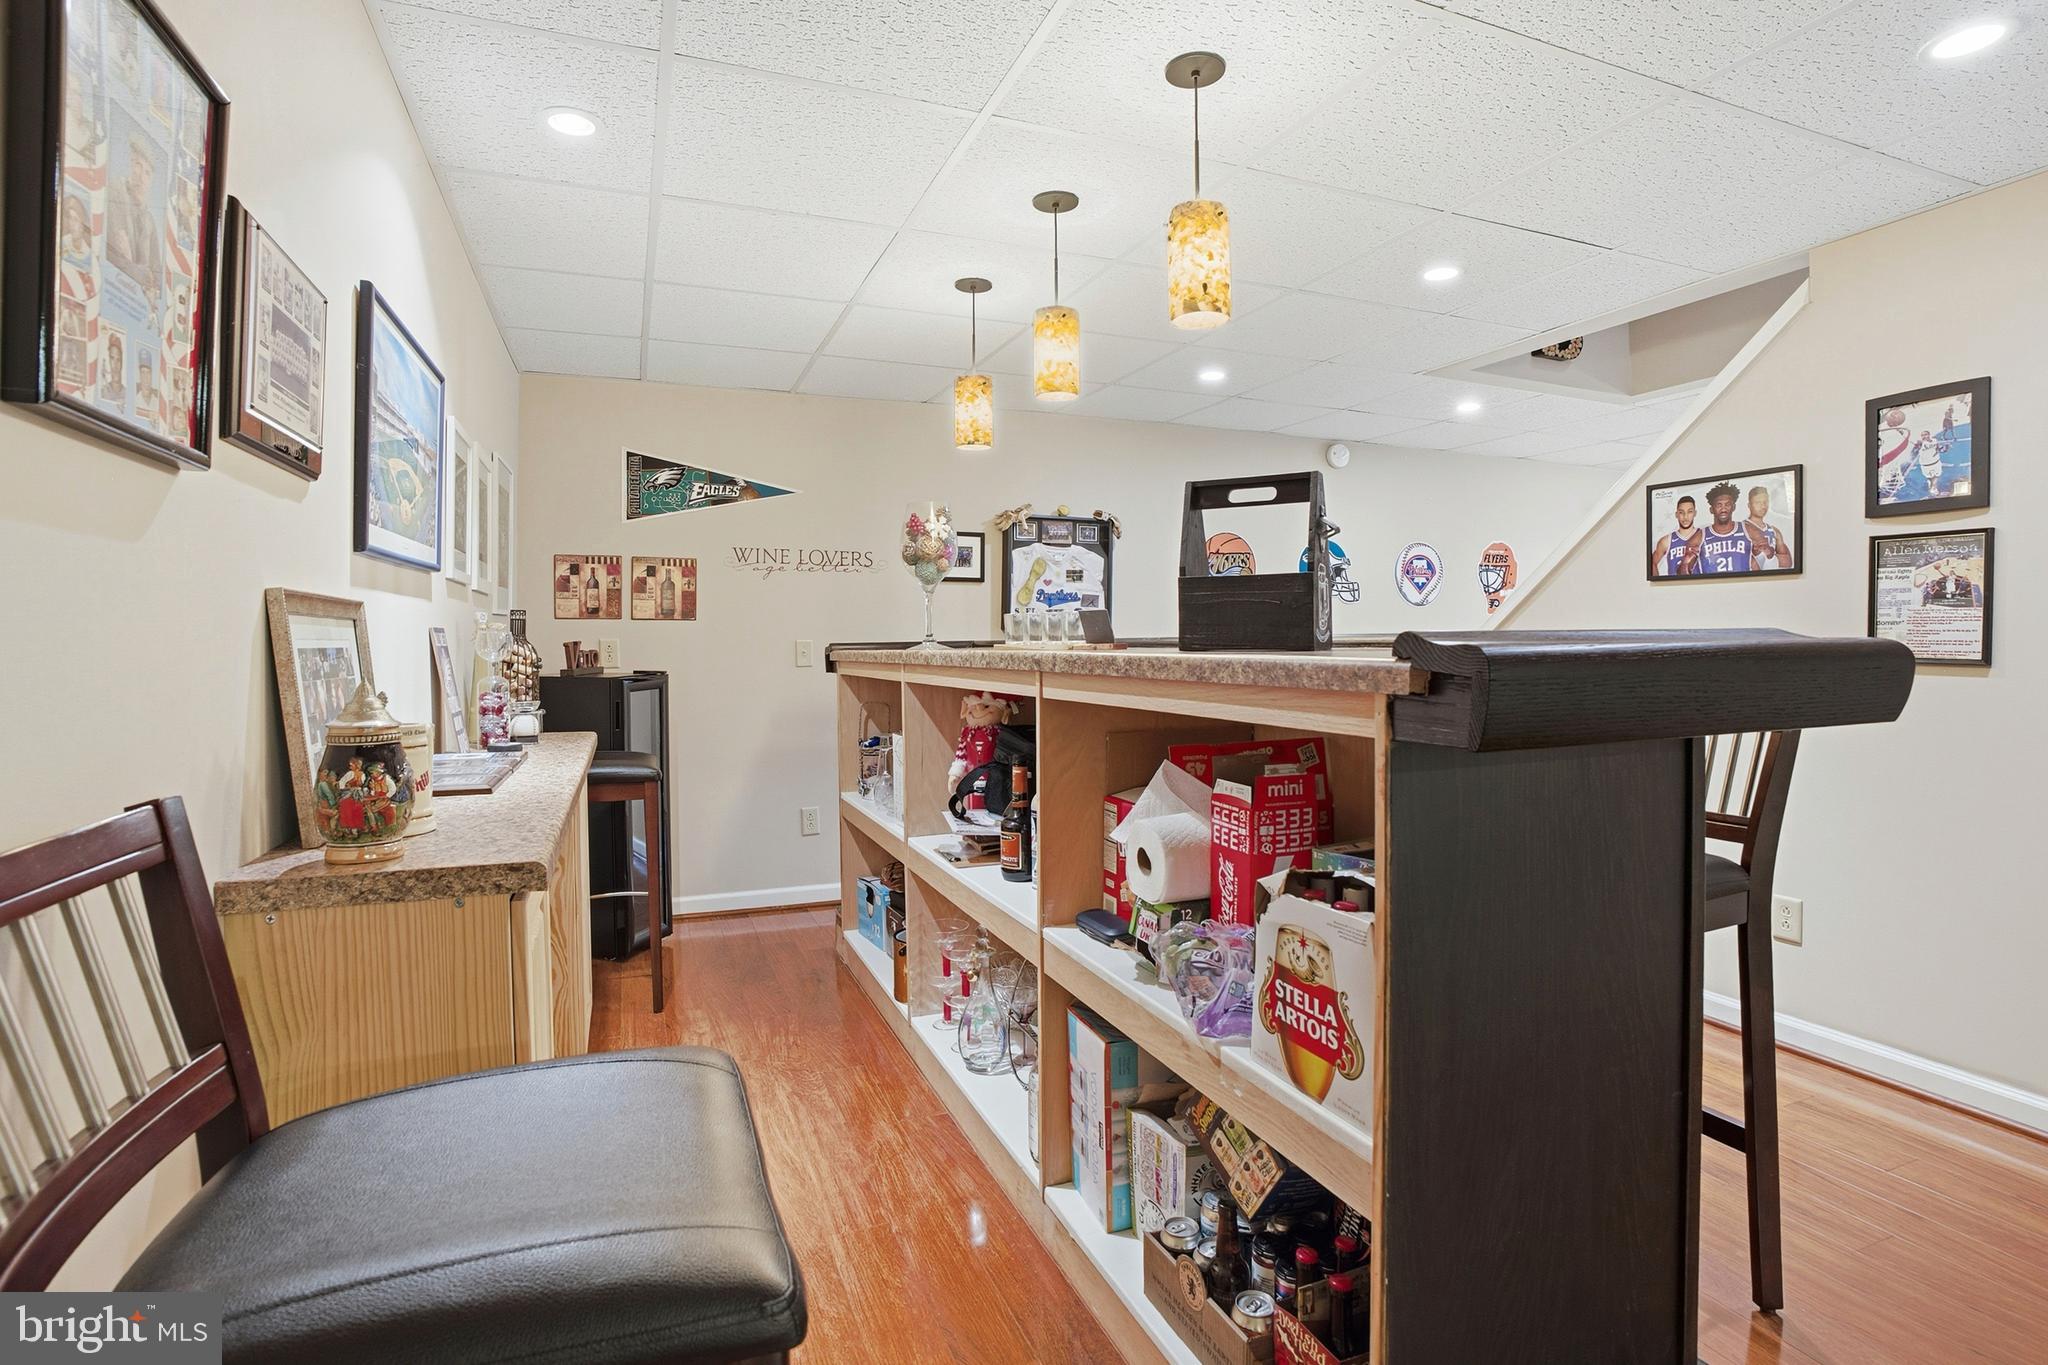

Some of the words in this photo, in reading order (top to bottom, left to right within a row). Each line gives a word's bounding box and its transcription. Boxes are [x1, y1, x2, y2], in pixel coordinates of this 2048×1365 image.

[627, 455, 642, 516] PHILADELPHIA
[690, 482, 741, 499] EAGLES
[733, 547, 791, 564] WINE
[799, 549, 874, 569] LOVERS
[1483, 553, 1509, 563] FLYERS
[1704, 540, 1746, 558] PHILA
[1883, 544, 1921, 557] Allen
[1922, 542, 1979, 554] Iverson
[752, 563, 787, 580] age
[793, 560, 862, 574] better
[1717, 556, 1734, 572] 21
[1268, 779, 1304, 798] mini
[1276, 810, 1289, 853] mini
[1290, 809, 1303, 852] mini
[1303, 808, 1315, 850] mini
[1181, 908, 1193, 920] 12
[1275, 979, 1338, 1028] STELLA
[1275, 1001, 1339, 1050] ARTOIS
[1191, 1162, 1209, 1195] WHITE
[1277, 1309, 1318, 1351] Dogfish
[1293, 1333, 1326, 1365] Head
